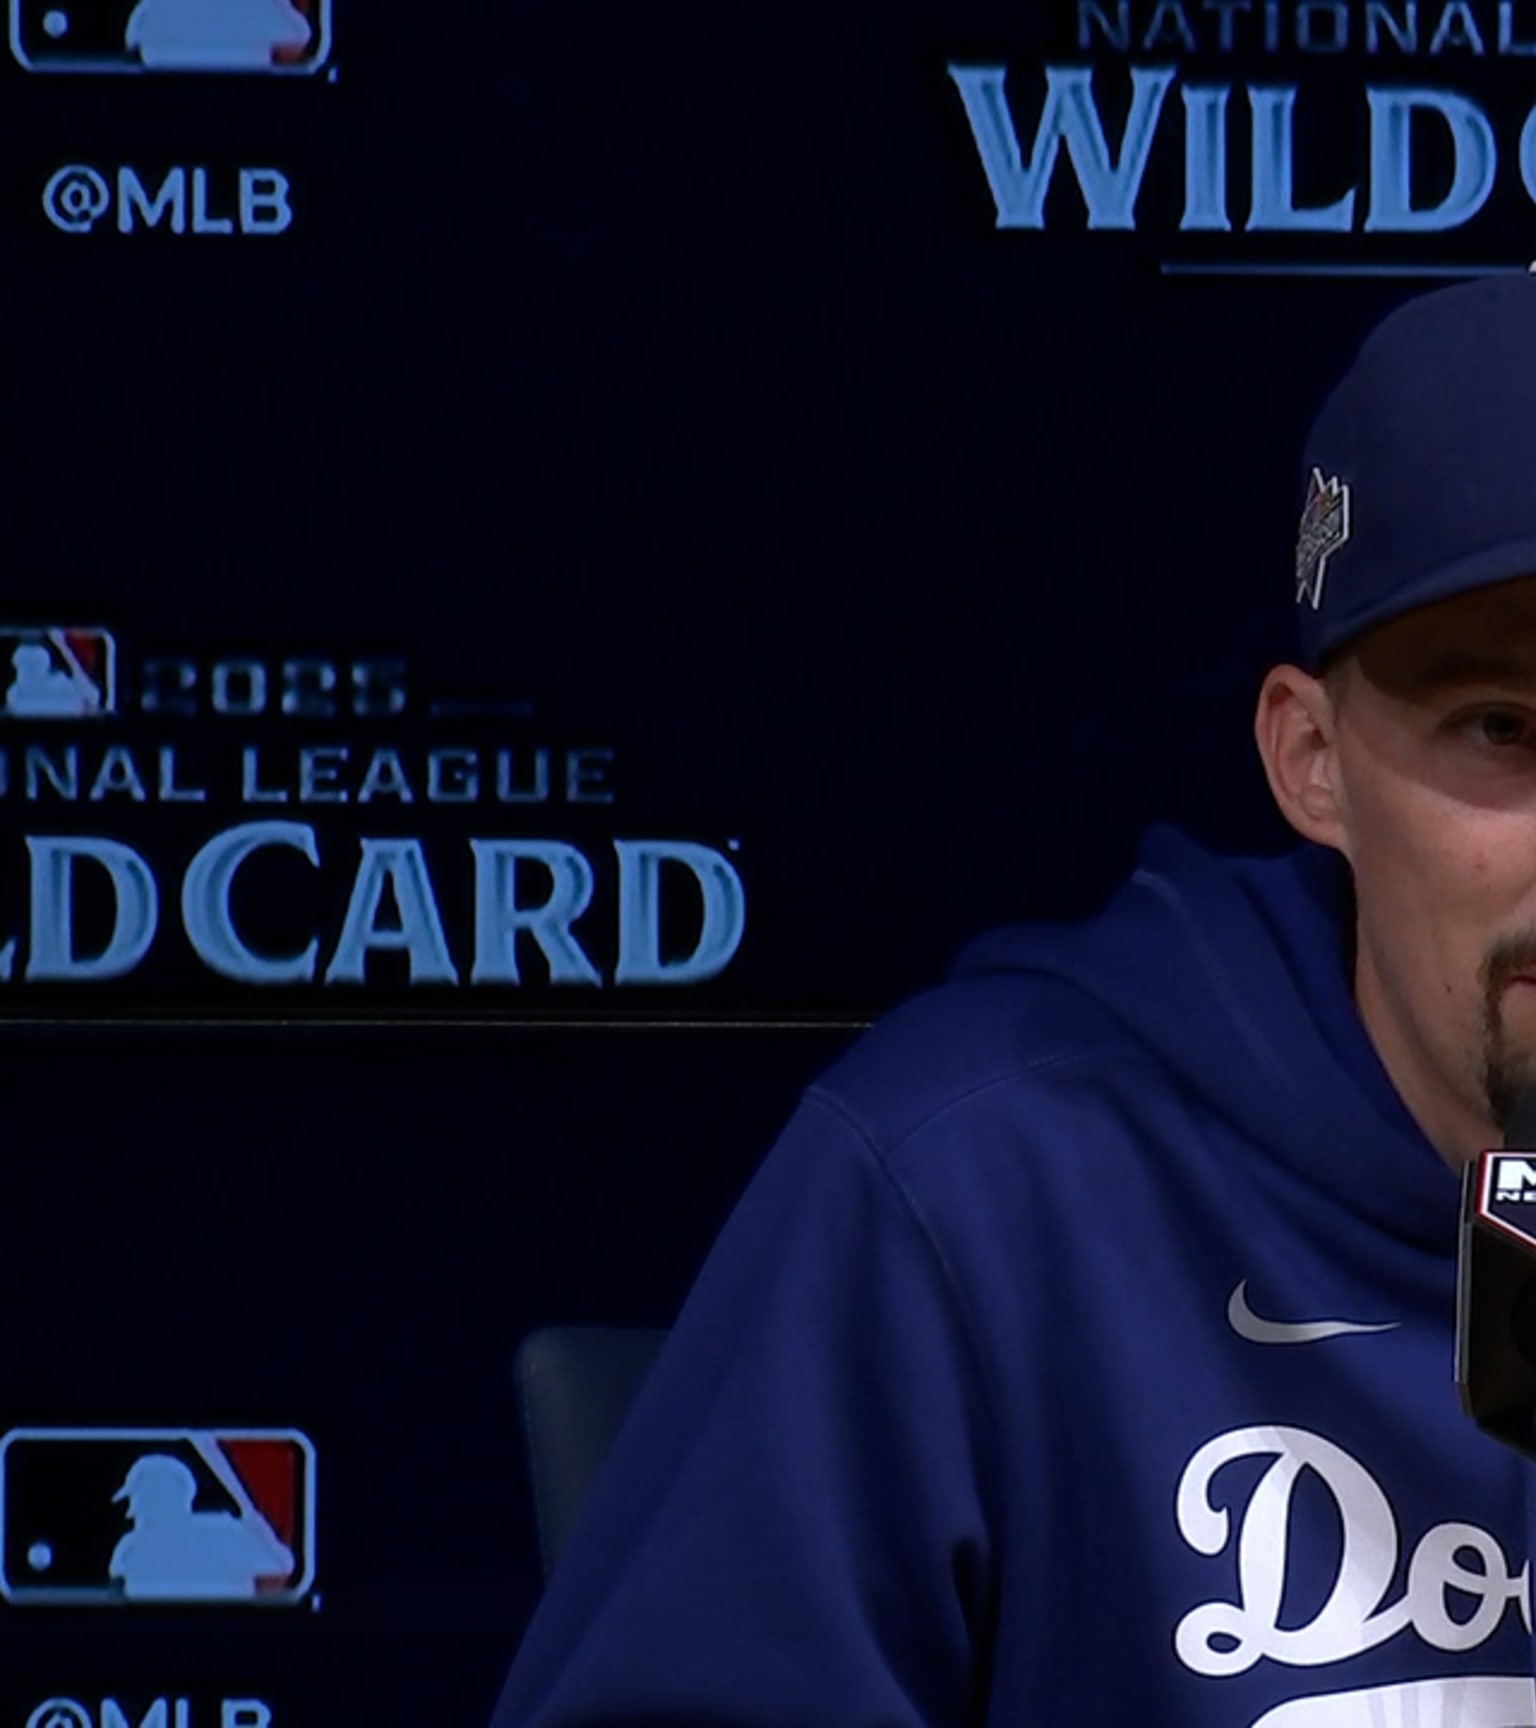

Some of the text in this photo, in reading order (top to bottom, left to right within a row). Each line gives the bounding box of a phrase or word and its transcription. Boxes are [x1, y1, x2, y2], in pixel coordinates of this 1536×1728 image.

[42, 164, 293, 235] @MLB
[140, 657, 408, 715] 2025
[0, 746, 614, 803] NAL LEAGUE
